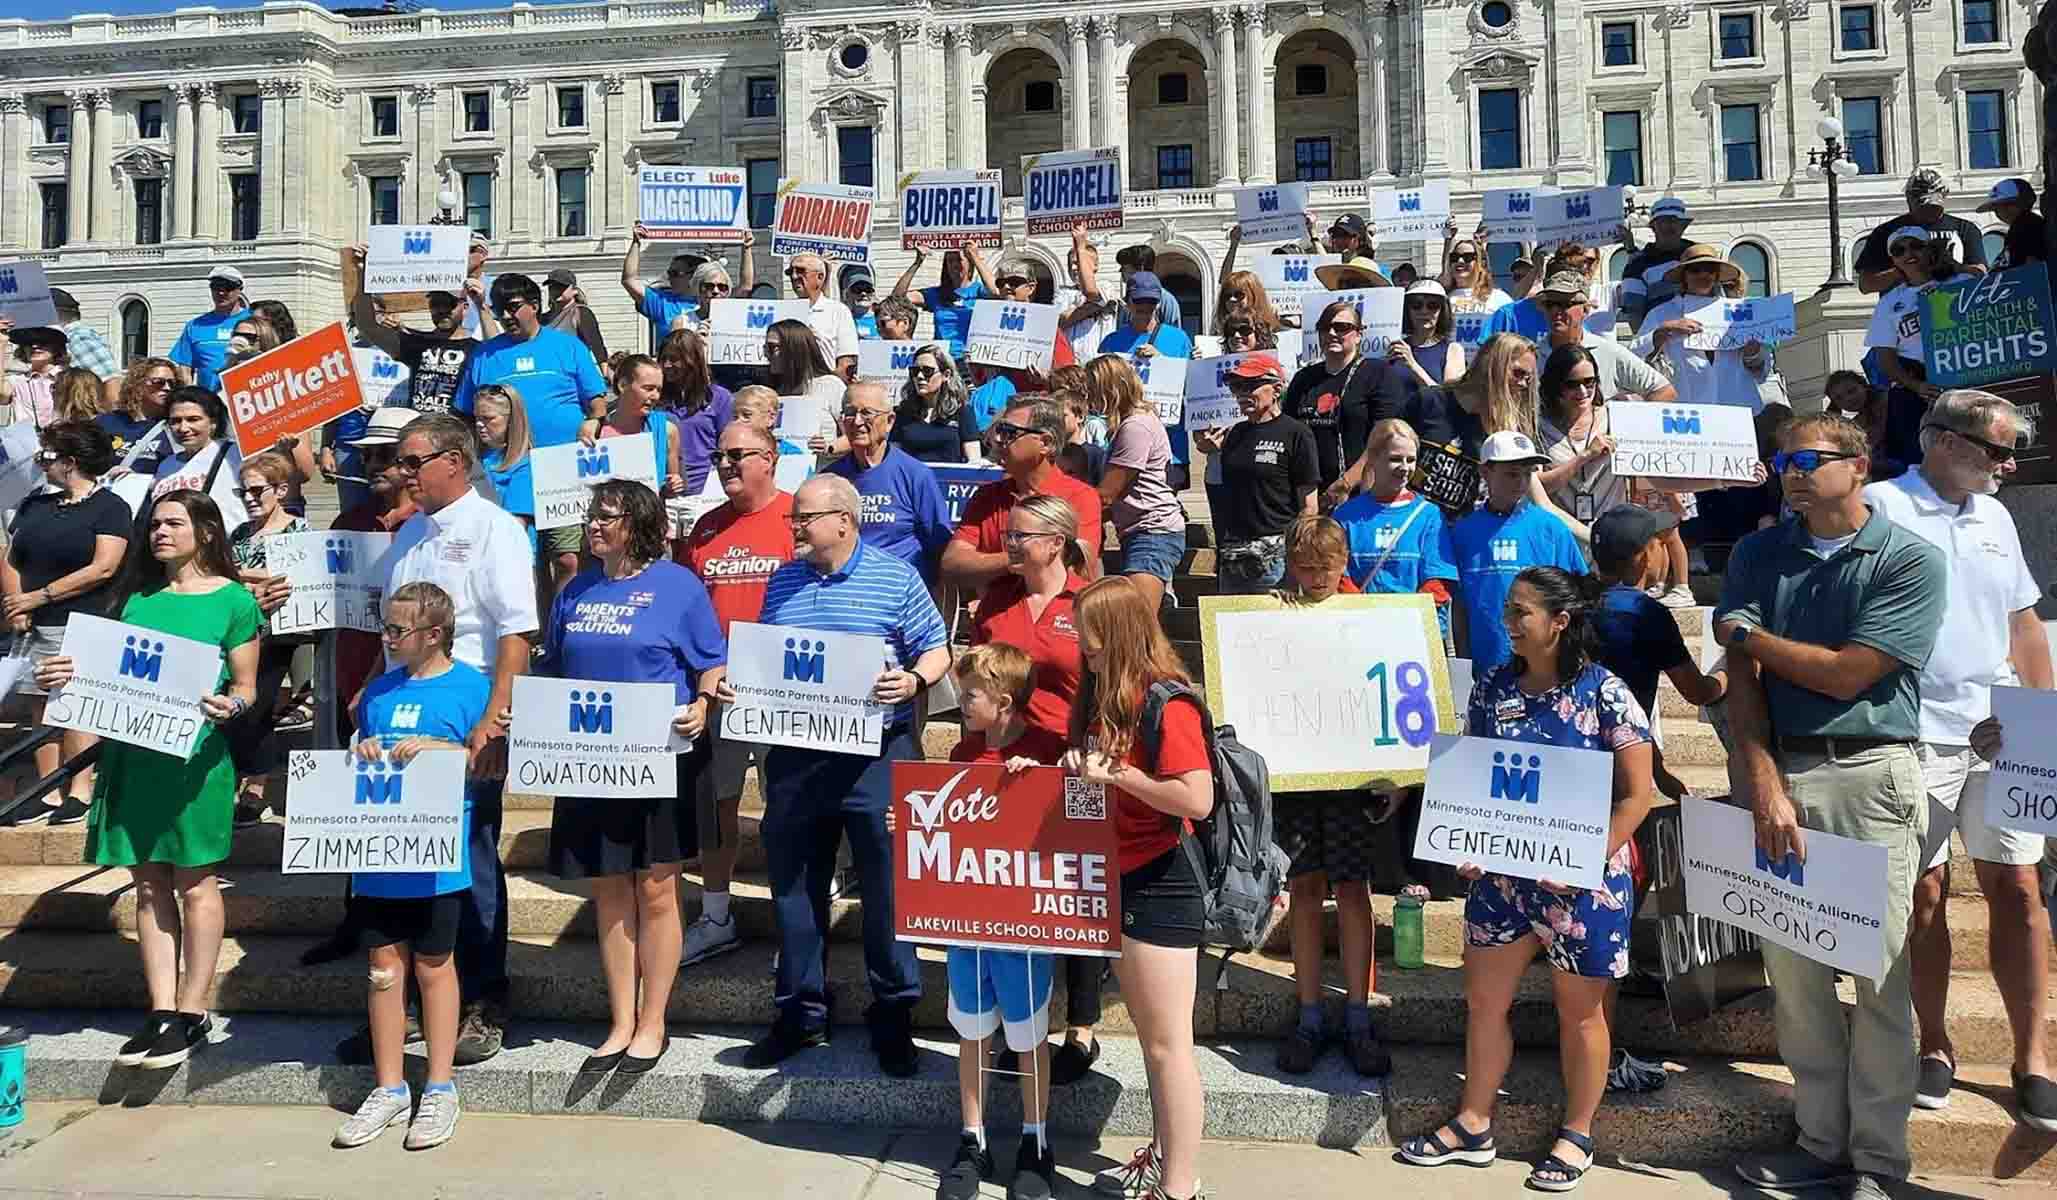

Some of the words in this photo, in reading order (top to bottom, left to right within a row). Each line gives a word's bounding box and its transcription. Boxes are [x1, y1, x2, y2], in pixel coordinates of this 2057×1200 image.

[1095, 147, 1118, 159] MIKE
[642, 171, 696, 183] ELECT
[709, 171, 741, 184] Luke
[976, 171, 1000, 180] MIKE
[1030, 163, 1118, 211] BURRELL
[642, 187, 733, 222] HAGGLUND
[779, 195, 870, 241] NDIRANGU
[905, 186, 998, 228] BURRELL
[959, 239, 1000, 248] BARD
[1957, 270, 2022, 314] Vote
[1279, 303, 1302, 312] SAVA
[1965, 301, 2024, 323] HEALTH
[2026, 295, 2039, 312] &
[1931, 313, 2042, 347] PARENTAL
[969, 342, 1000, 361] PINE
[1006, 348, 1043, 366] CITY
[1933, 329, 2049, 376] RIGHTS
[232, 349, 350, 425] Burkett
[248, 368, 281, 390] Kathy
[1615, 450, 1697, 475] FOREST
[1707, 453, 1757, 479] LAKE
[545, 498, 586, 521] MOUN
[860, 495, 892, 506] ENTS
[862, 512, 896, 523] TION
[703, 556, 780, 576] Scanlon
[723, 545, 751, 559] Joe
[278, 600, 330, 630] ELK
[575, 602, 638, 617] PARENTS
[565, 621, 633, 635] SOLUTION
[120, 685, 162, 702] Parents
[164, 694, 200, 713] Allianc
[728, 683, 786, 698] Minnesota
[788, 688, 831, 704] Parents
[832, 692, 880, 708] Alliance
[1366, 661, 1436, 748] 18
[50, 692, 196, 749] STILLWATER
[726, 706, 880, 745] CENTENNIAL
[290, 750, 312, 767] ISD
[512, 737, 573, 752] Minnesota
[575, 741, 620, 756] Parents
[623, 745, 673, 755] Alliance
[519, 759, 656, 787] OWATONNA
[1994, 759, 2057, 779] Minneso
[903, 767, 1000, 834] Vote
[2002, 786, 2057, 821] SHO
[290, 814, 358, 826] Minnesota
[360, 814, 409, 826] Parents
[411, 813, 459, 826] Alliance
[1426, 799, 1492, 819] Minnesota
[1494, 809, 1545, 828] Parents
[1548, 817, 1605, 837] Alliance
[286, 835, 457, 870] ZIMMERMAN
[906, 829, 1108, 892] MARILEE
[1427, 824, 1584, 870] CENTENNIAL
[1031, 892, 1108, 919] JAGER
[1688, 857, 1761, 888] Minnesota
[1763, 881, 1815, 911] Parents
[1817, 902, 1881, 929] Alliance
[906, 915, 981, 935] LAKEVILLE
[985, 921, 1050, 940] SCHOOL
[1054, 926, 1111, 945] BOARD
[1722, 890, 1837, 952] ORONO
